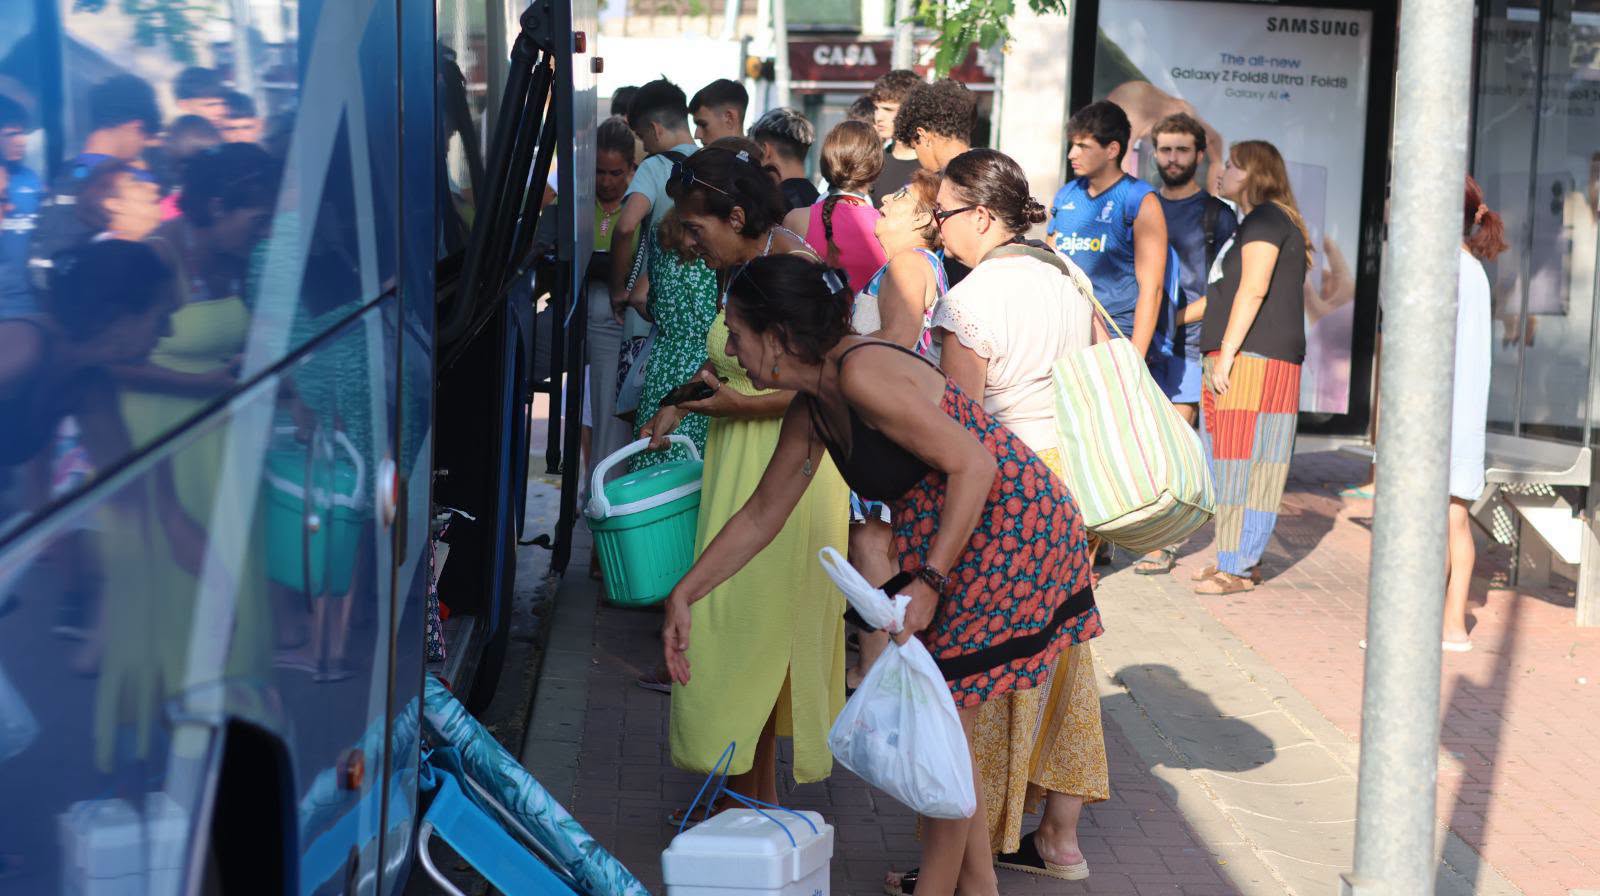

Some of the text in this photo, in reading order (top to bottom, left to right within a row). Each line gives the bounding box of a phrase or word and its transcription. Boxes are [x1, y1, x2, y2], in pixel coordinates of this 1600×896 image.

[1266, 16, 1360, 37] SAMSUNG
[813, 45, 877, 66] CASA
[1220, 52, 1302, 69] The all-new
[1171, 67, 1348, 89] Galaxy Z Fold8 Ultra Fold8
[1225, 87, 1265, 101] Galaxy
[1054, 232, 1107, 256] Cajasol
